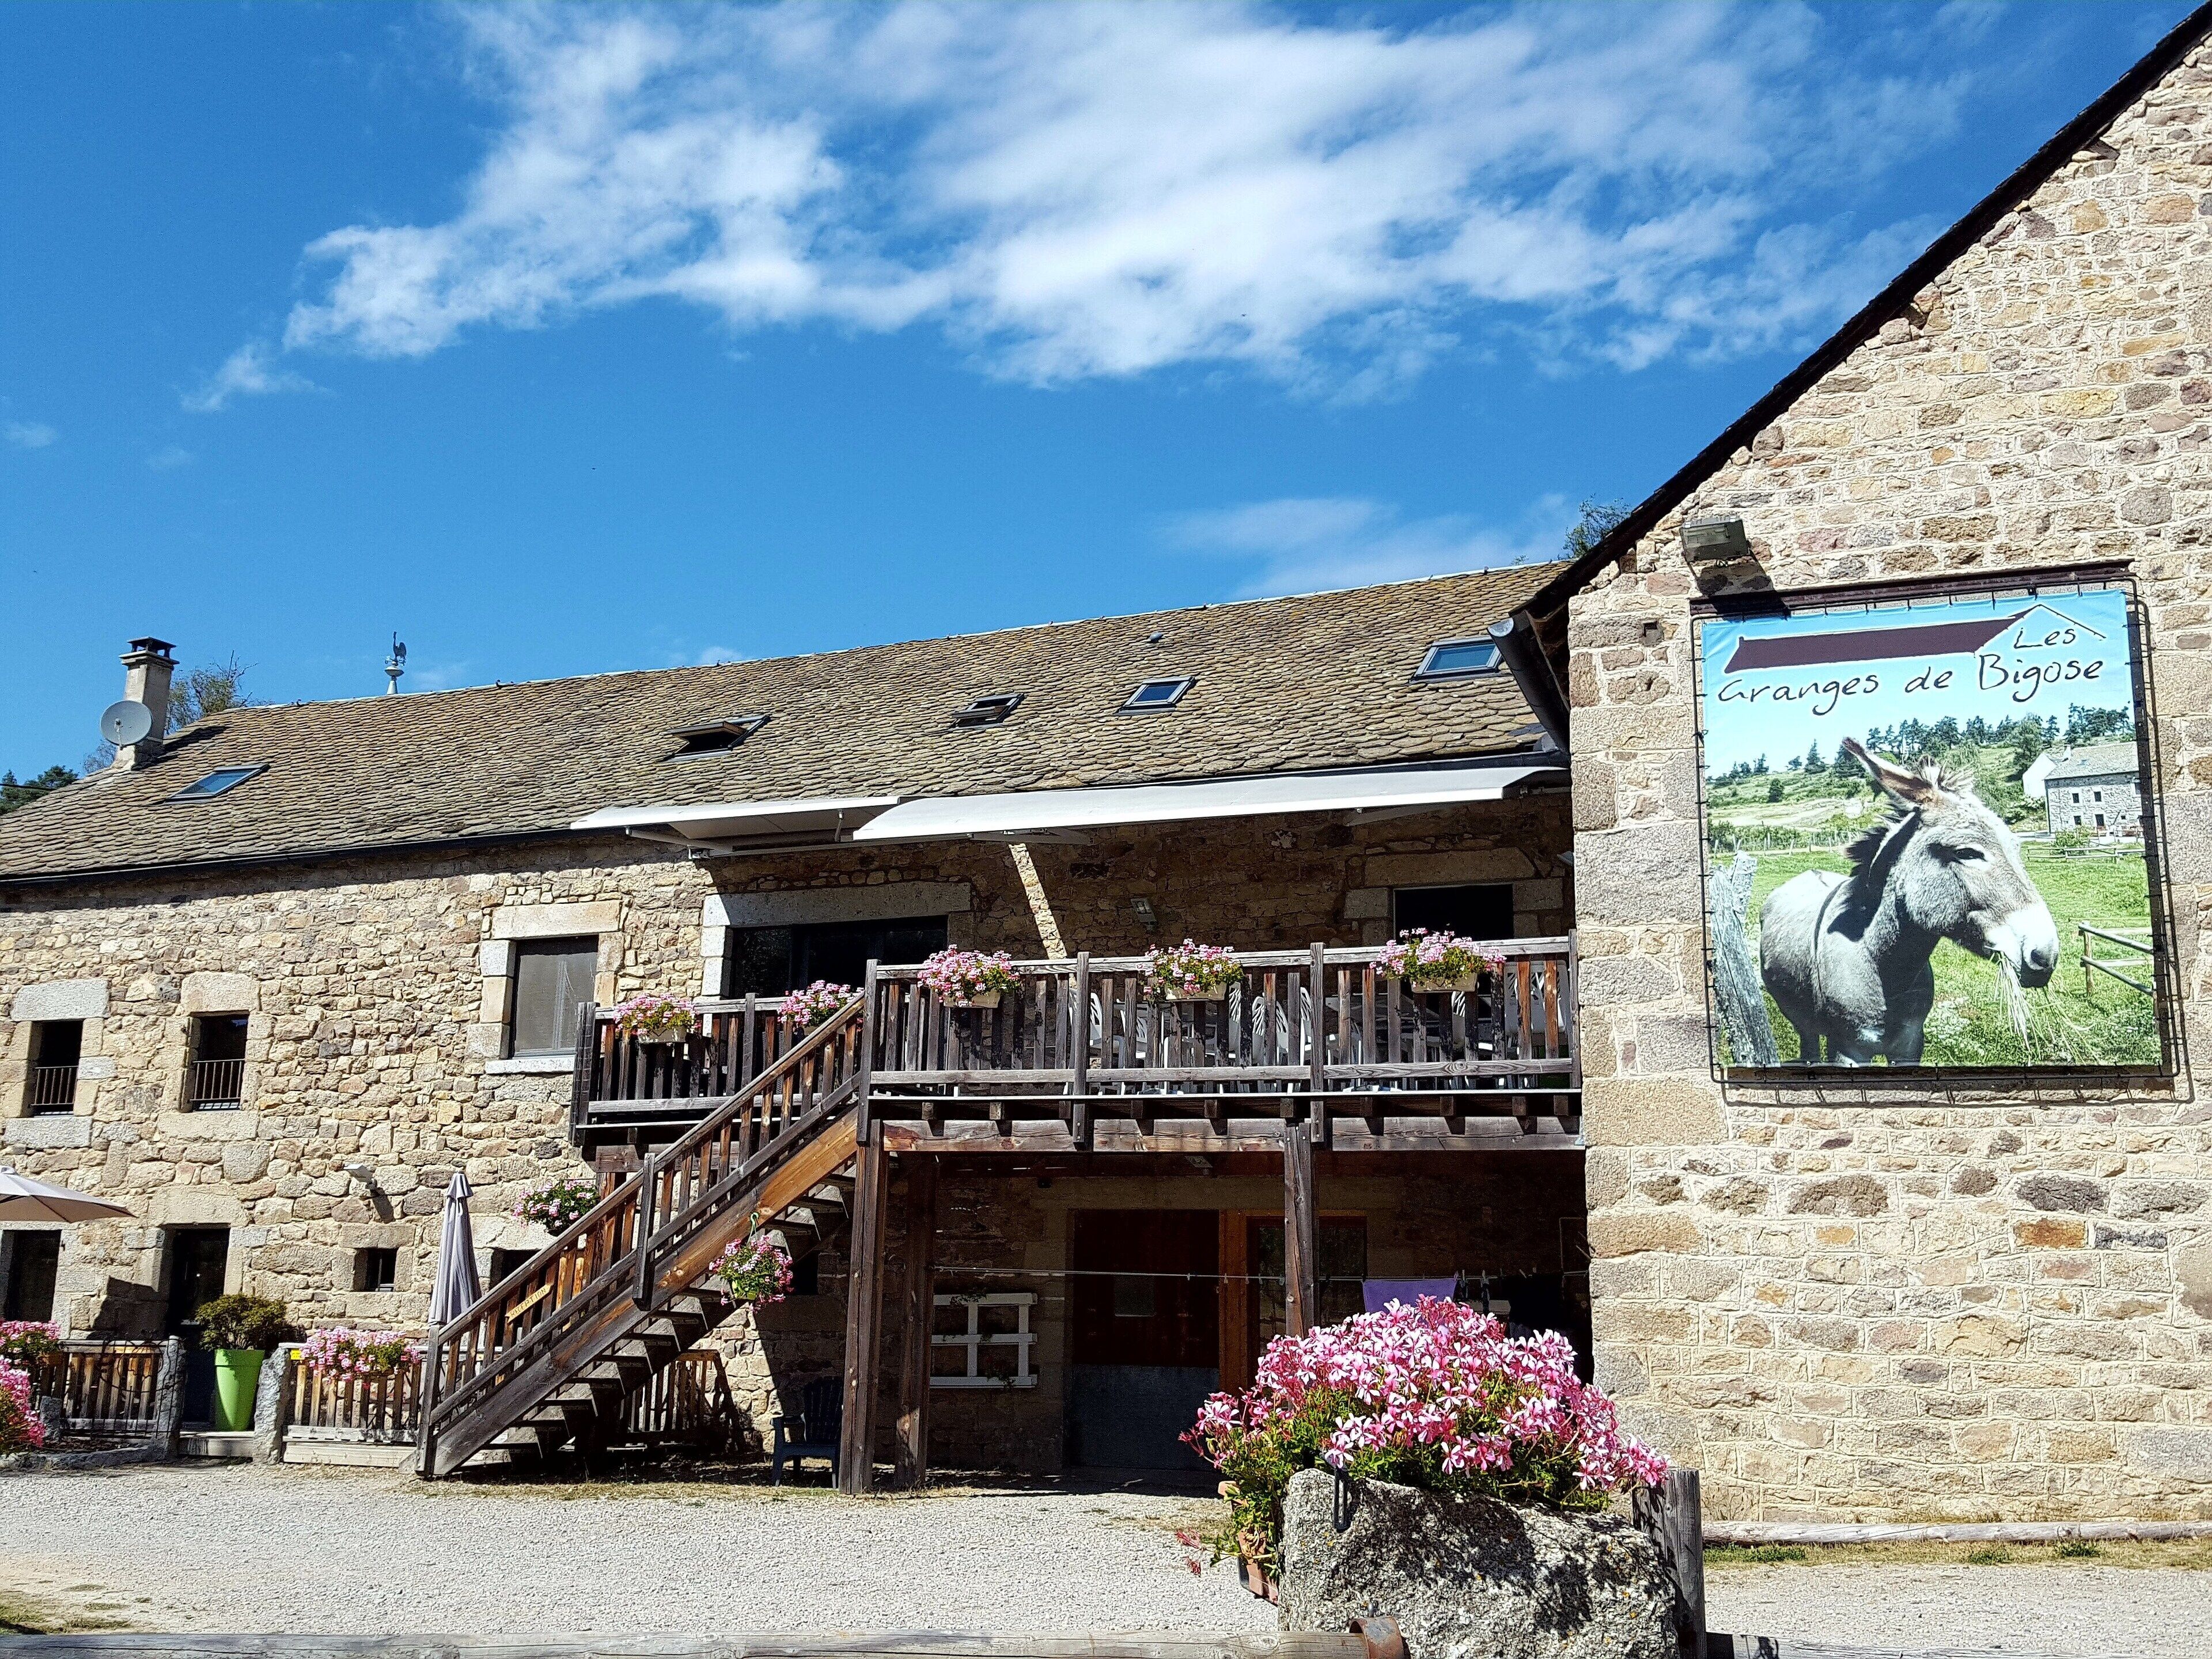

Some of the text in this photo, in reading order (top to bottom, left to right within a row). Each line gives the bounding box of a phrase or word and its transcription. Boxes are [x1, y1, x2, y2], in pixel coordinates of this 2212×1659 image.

[2013, 627, 2076, 649] Les
[1718, 654, 2104, 715] Granges de Bigose
